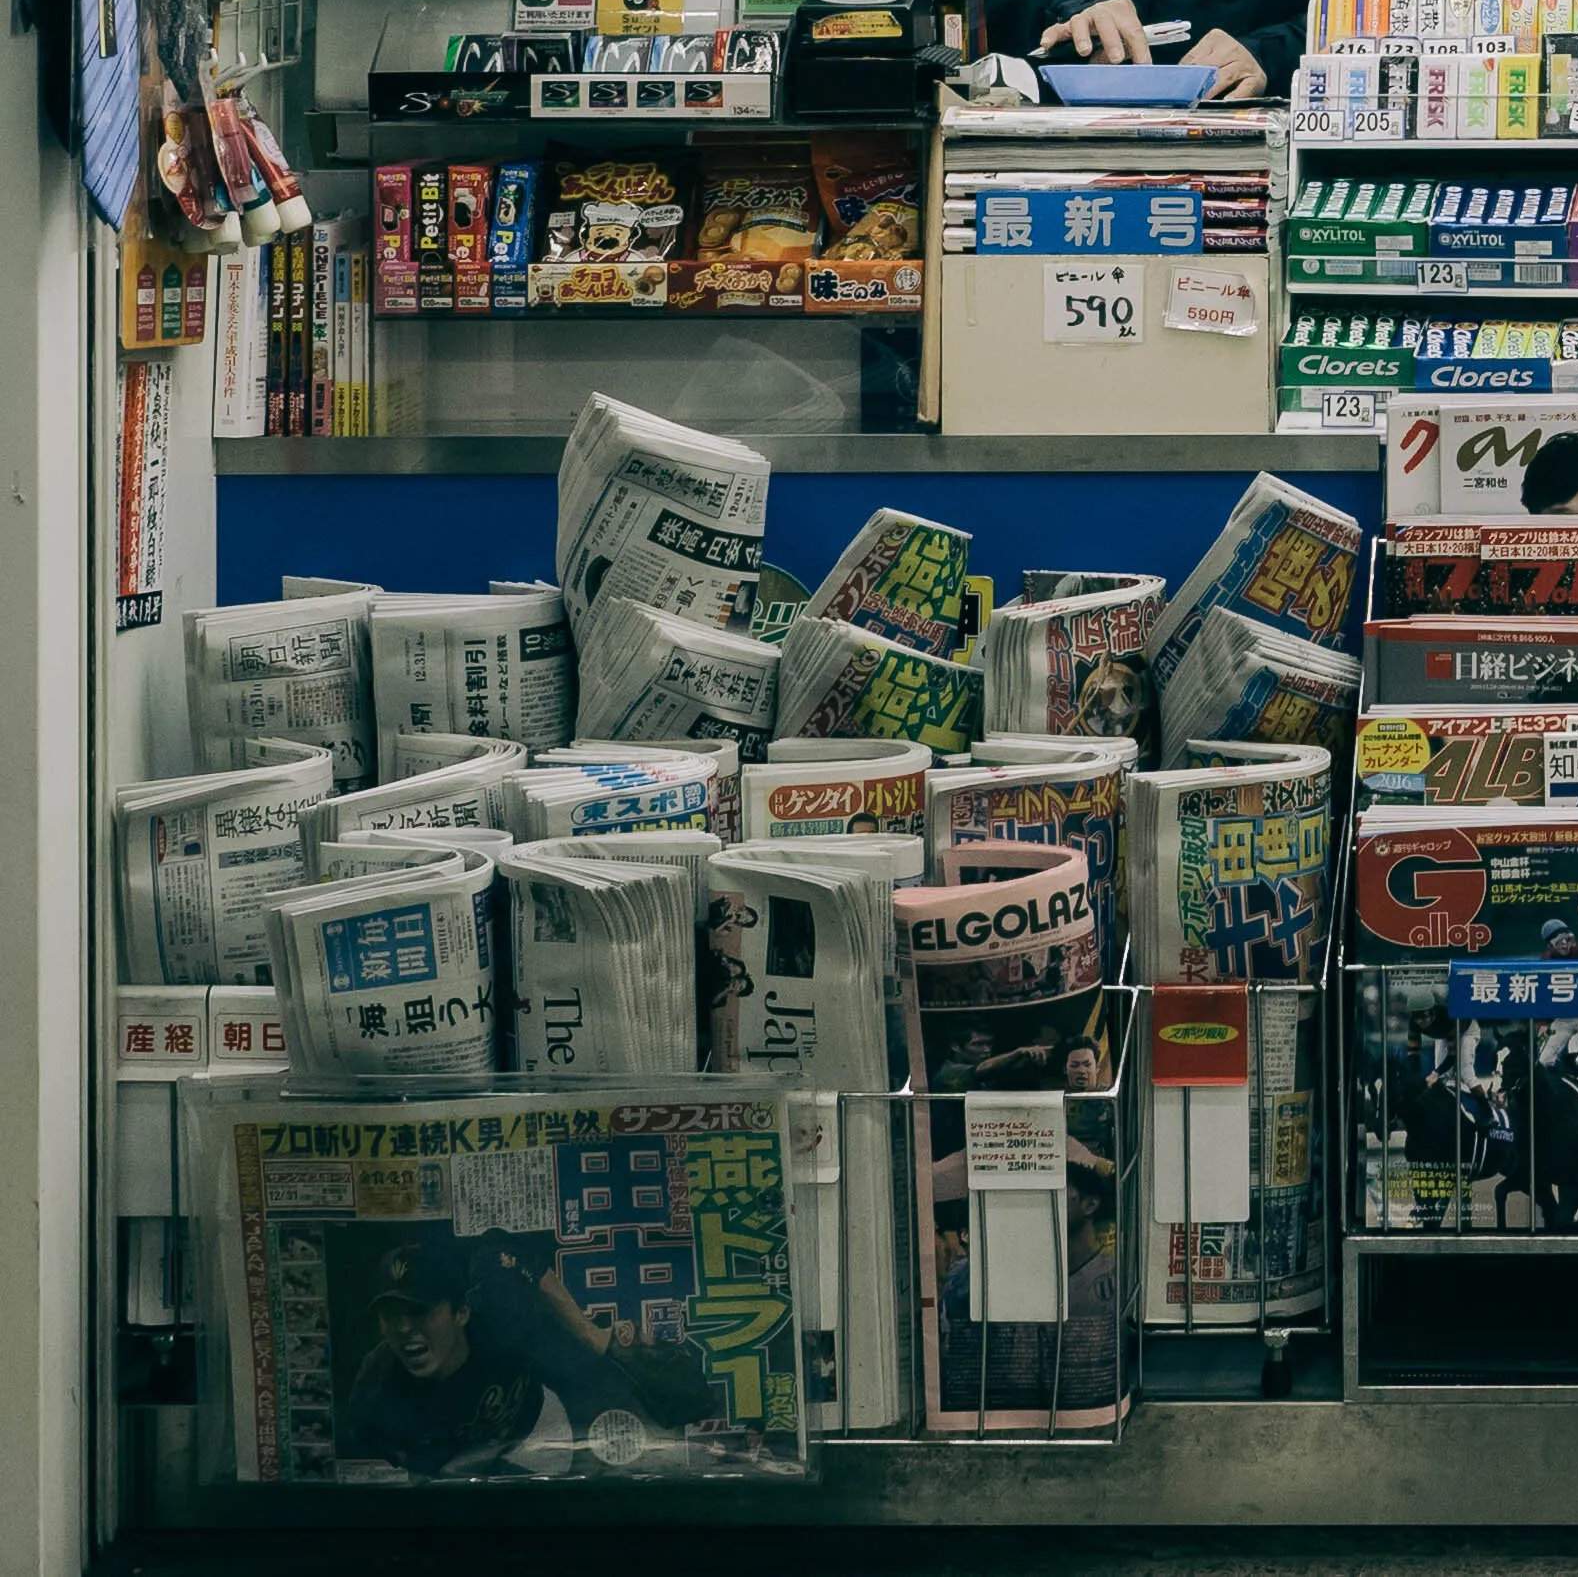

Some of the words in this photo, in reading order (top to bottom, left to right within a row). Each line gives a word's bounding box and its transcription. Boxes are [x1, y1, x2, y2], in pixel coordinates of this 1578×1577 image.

[981, 196, 1199, 248] 最新号
[1312, 228, 1366, 243] XYLITOL
[1451, 232, 1506, 249] XYLITOL
[315, 245, 328, 275] ONE
[316, 276, 328, 320] PIECE
[1066, 295, 1134, 327] 590
[1187, 307, 1235, 324] 590円
[1298, 355, 1400, 376] Clorets
[1430, 367, 1533, 388] Clorets
[1463, 476, 1508, 488] 二宮和也
[238, 630, 344, 675] 朝日新聞
[1364, 756, 1420, 768] カレンダー
[583, 792, 678, 821] 東スポ
[1492, 893, 1570, 903] ロングインタビュー
[1471, 973, 1578, 1004] 最新号
[126, 1024, 194, 1053] 産経
[223, 1023, 286, 1051] 朝日
[540, 987, 583, 1067] The
[617, 1105, 743, 1132] サンスポ
